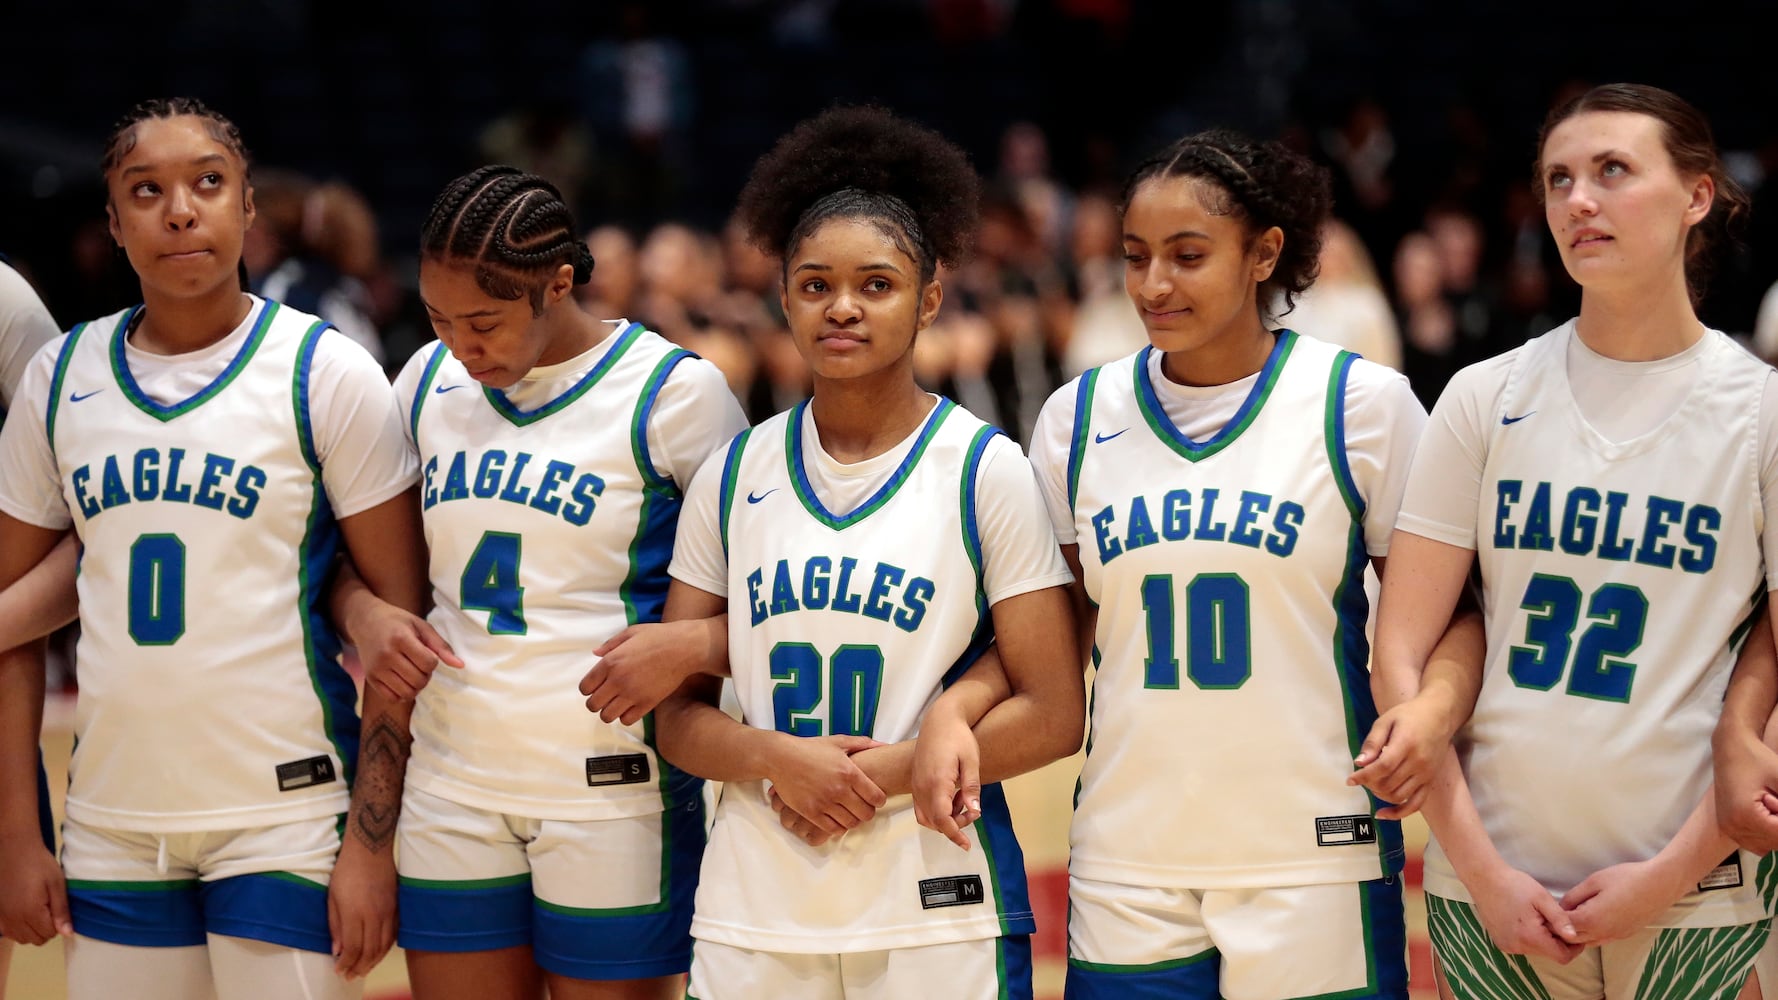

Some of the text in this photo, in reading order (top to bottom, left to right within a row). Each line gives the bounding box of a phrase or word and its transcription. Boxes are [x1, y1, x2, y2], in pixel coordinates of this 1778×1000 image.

[72, 448, 267, 520] EAGLES
[424, 449, 606, 527] EAGLES
[1091, 488, 1305, 566] EAGLES
[1494, 479, 1722, 574] EAGLES
[128, 533, 186, 646] 0
[460, 530, 528, 635] 4
[747, 555, 936, 633] EAGLES
[1140, 572, 1252, 690] 10
[1507, 572, 1649, 704] 32
[769, 641, 885, 739] 20
[316, 762, 328, 776] M
[631, 763, 640, 775] S
[1359, 824, 1369, 835] M
[963, 883, 976, 896] M
